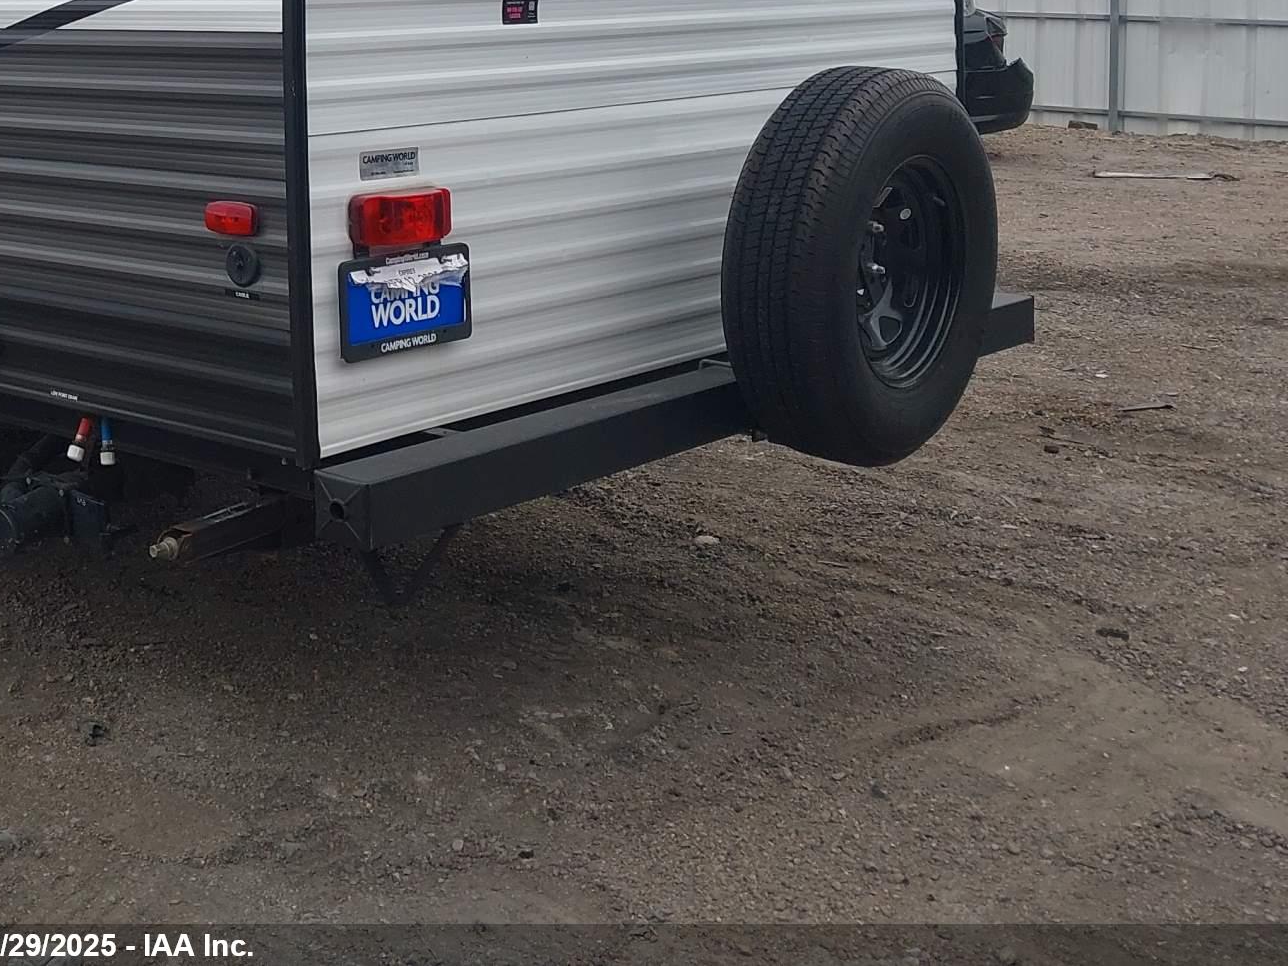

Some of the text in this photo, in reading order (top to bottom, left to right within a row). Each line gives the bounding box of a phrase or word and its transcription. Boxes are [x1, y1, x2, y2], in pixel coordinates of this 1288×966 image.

[363, 151, 416, 164] CAMPING WORLD
[372, 295, 440, 328] WORLD
[381, 333, 437, 353] CAMPING WORLD
